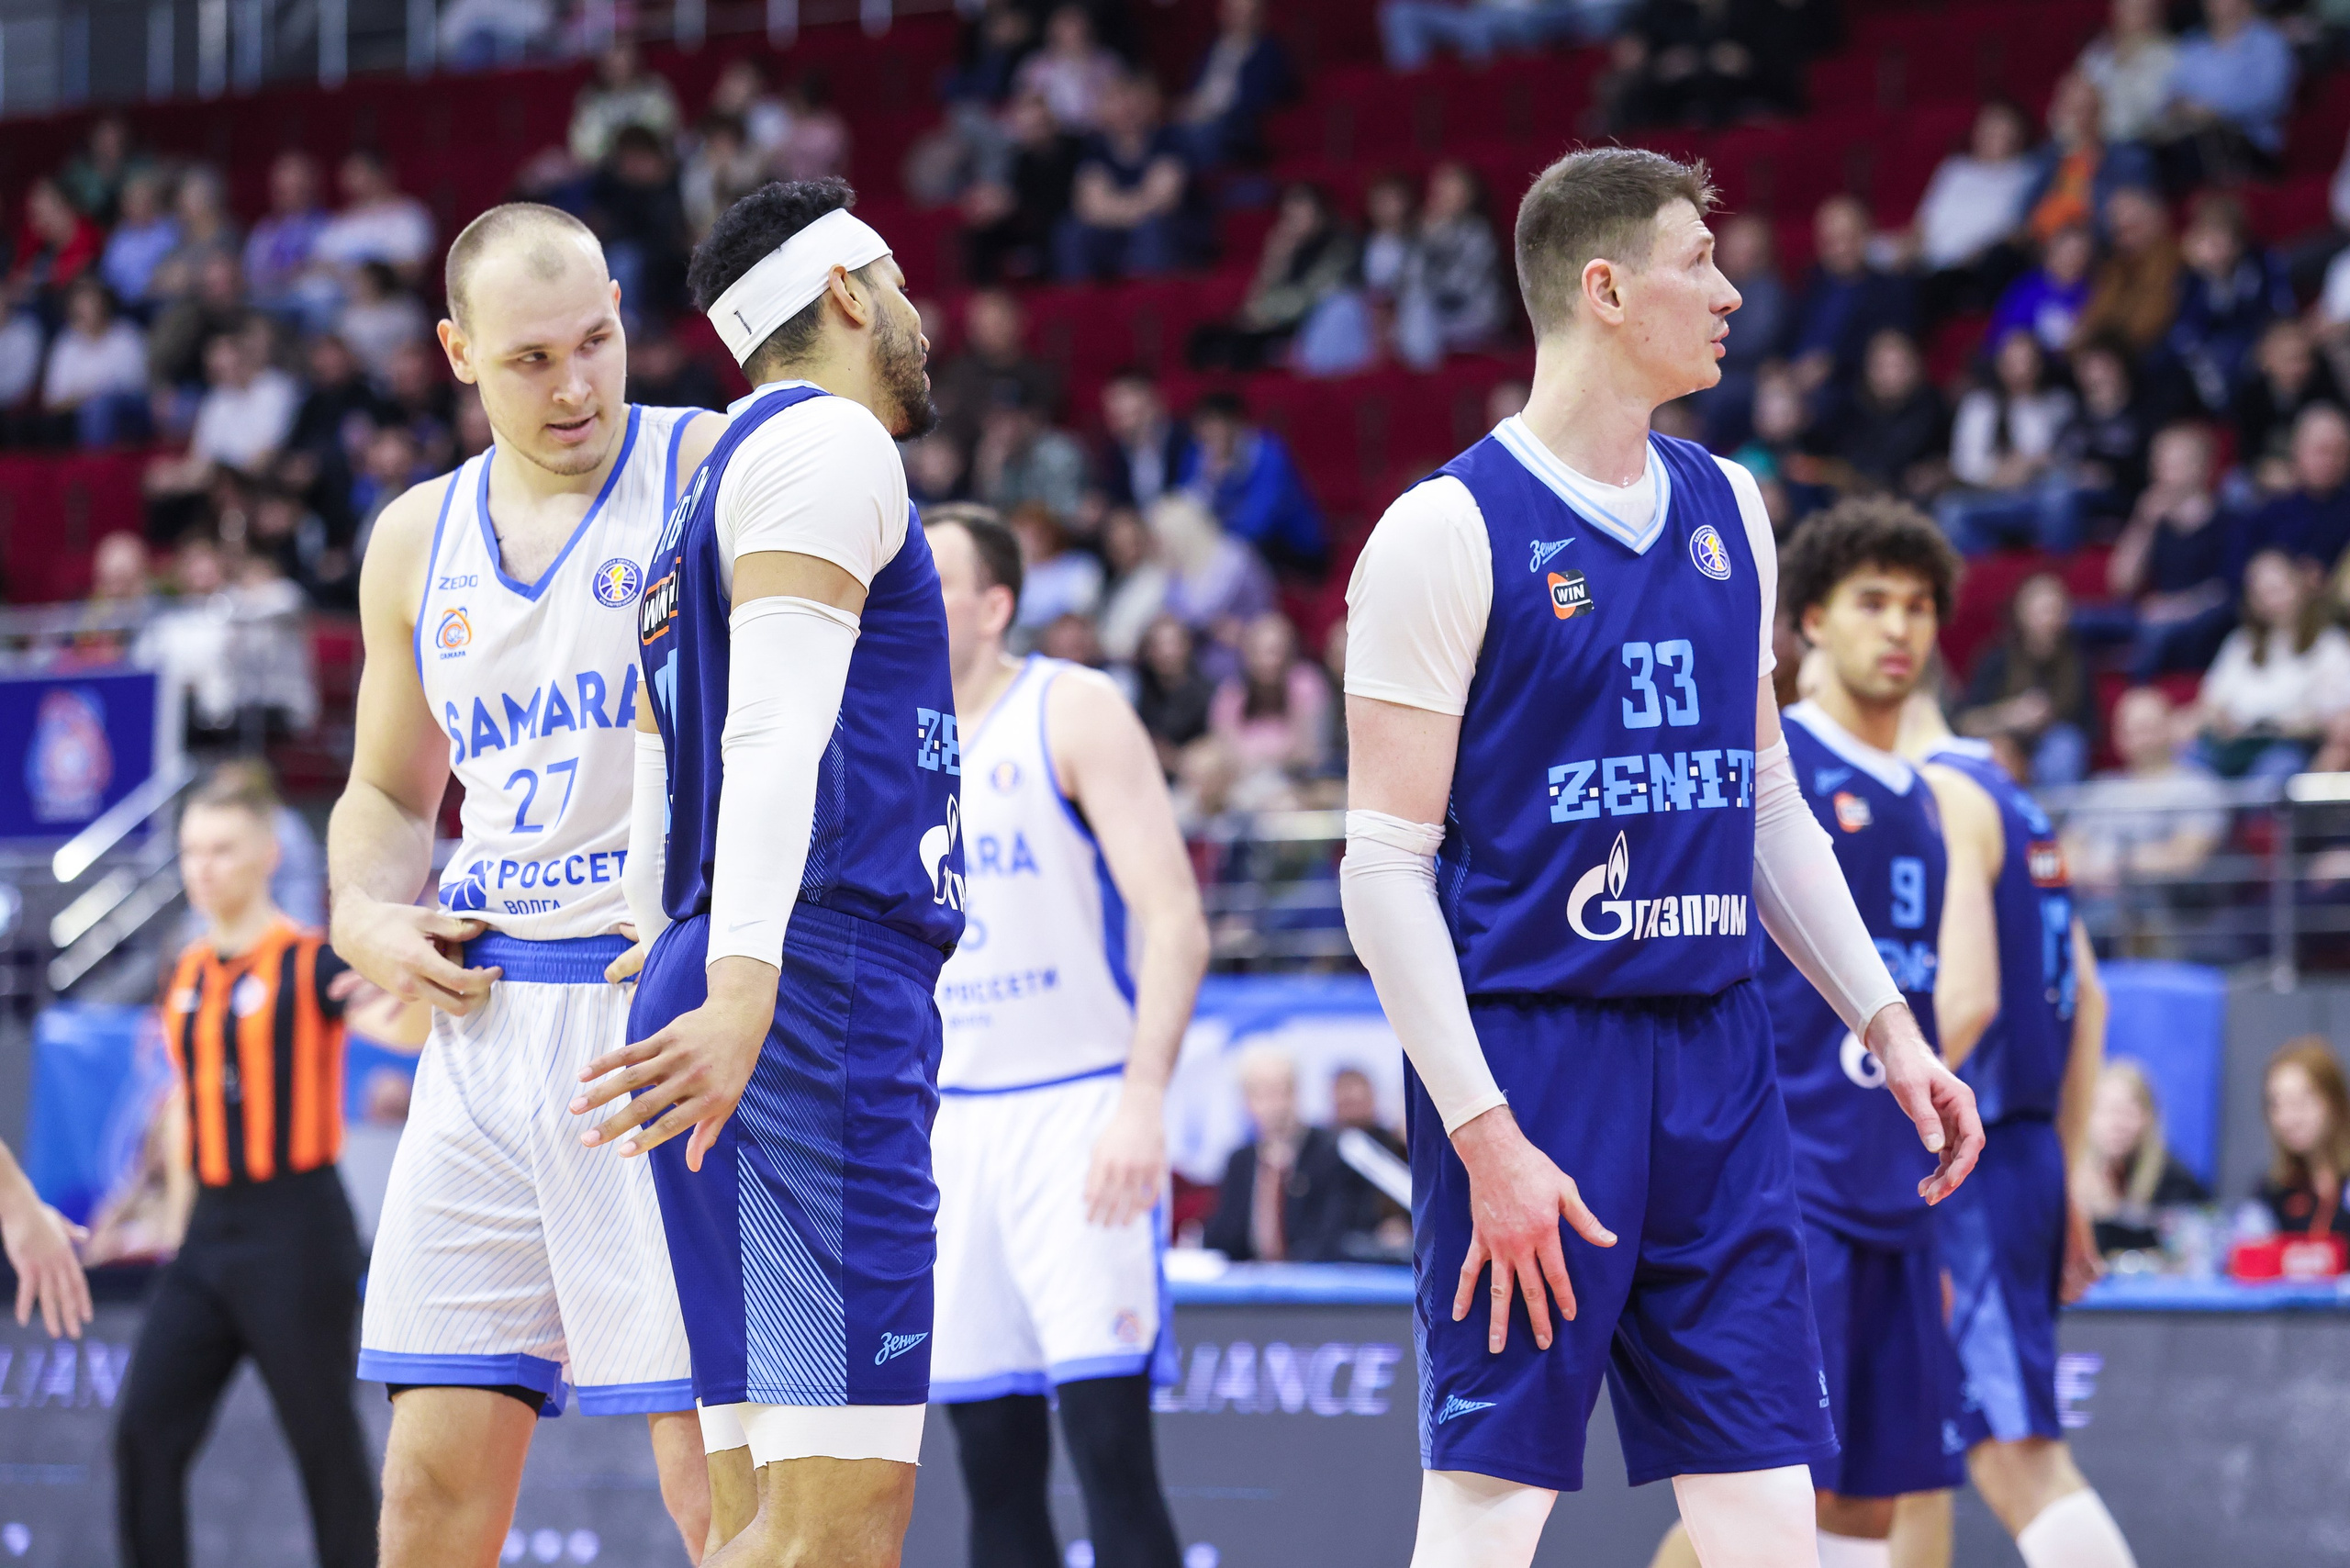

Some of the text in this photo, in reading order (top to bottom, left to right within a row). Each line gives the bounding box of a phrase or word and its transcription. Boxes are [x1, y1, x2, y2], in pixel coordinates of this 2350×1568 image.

[1557, 584, 1584, 602] WIN
[1622, 639, 1699, 729] 33
[503, 756, 579, 834] 27
[1548, 749, 1755, 823] ZENIT
[1632, 894, 1748, 940] ГАЗПРОМ
[1890, 856, 1926, 929] 9
